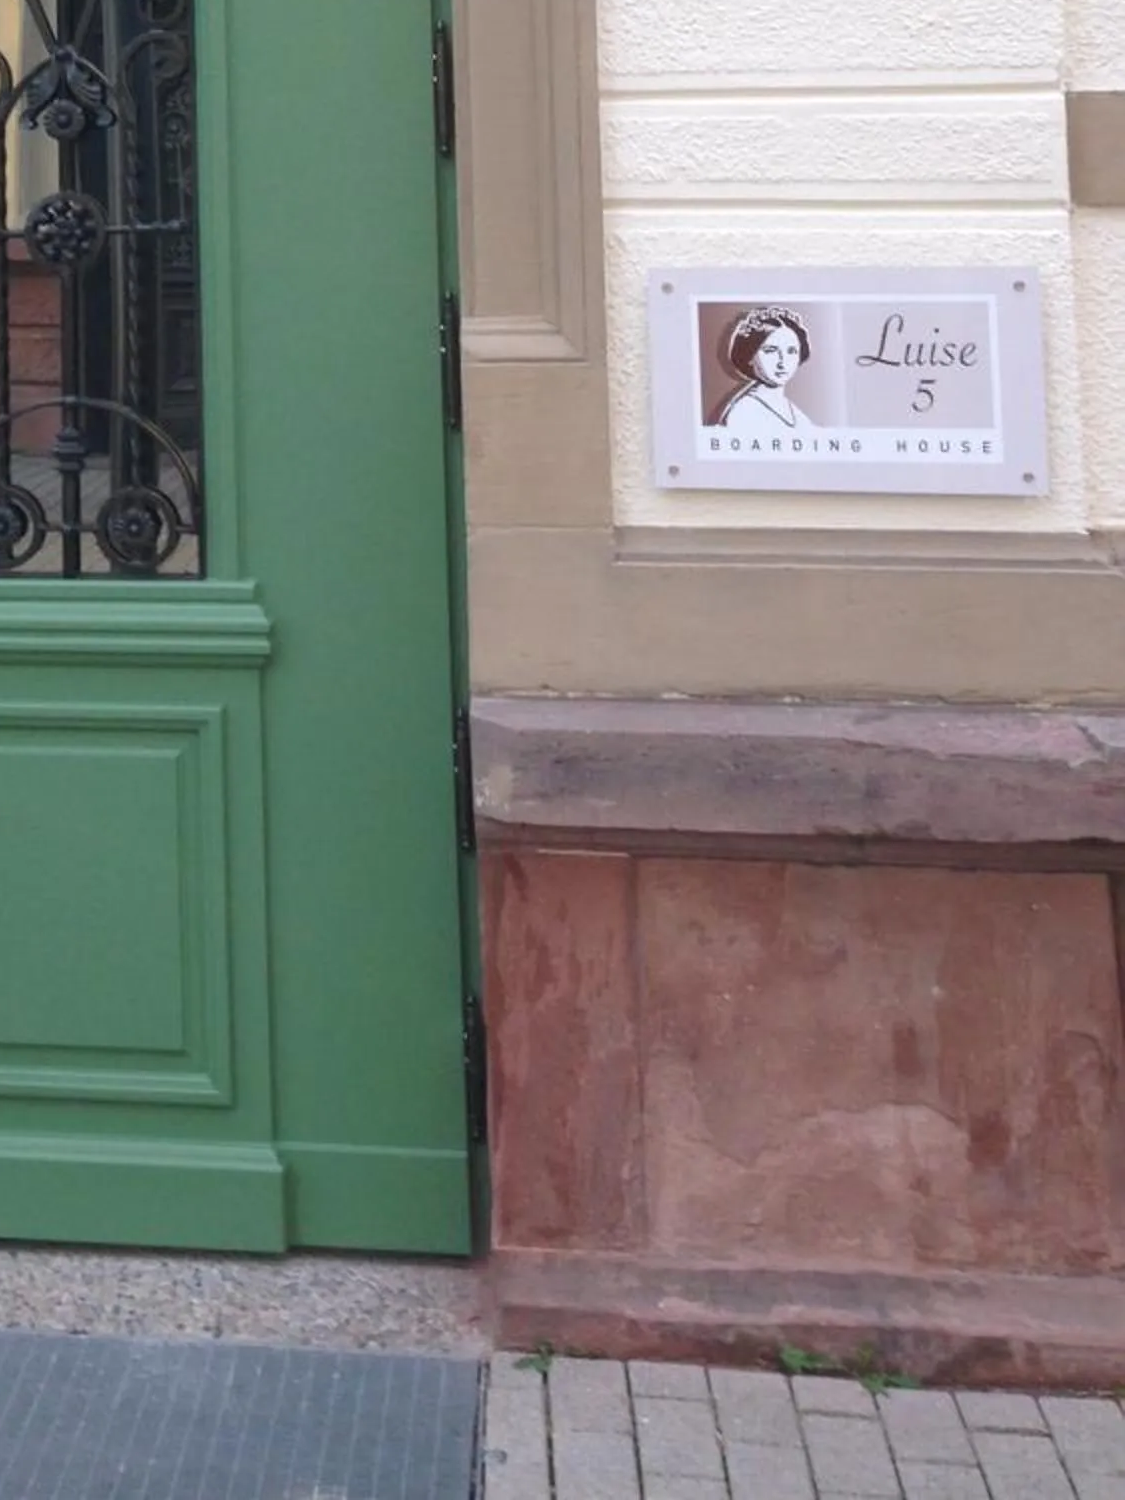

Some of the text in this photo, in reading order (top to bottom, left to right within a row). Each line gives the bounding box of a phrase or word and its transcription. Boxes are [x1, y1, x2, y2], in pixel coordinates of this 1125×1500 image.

[855, 313, 977, 368] Luise
[911, 378, 937, 413] 5
[710, 437, 994, 455] BOARDING HOUSE
